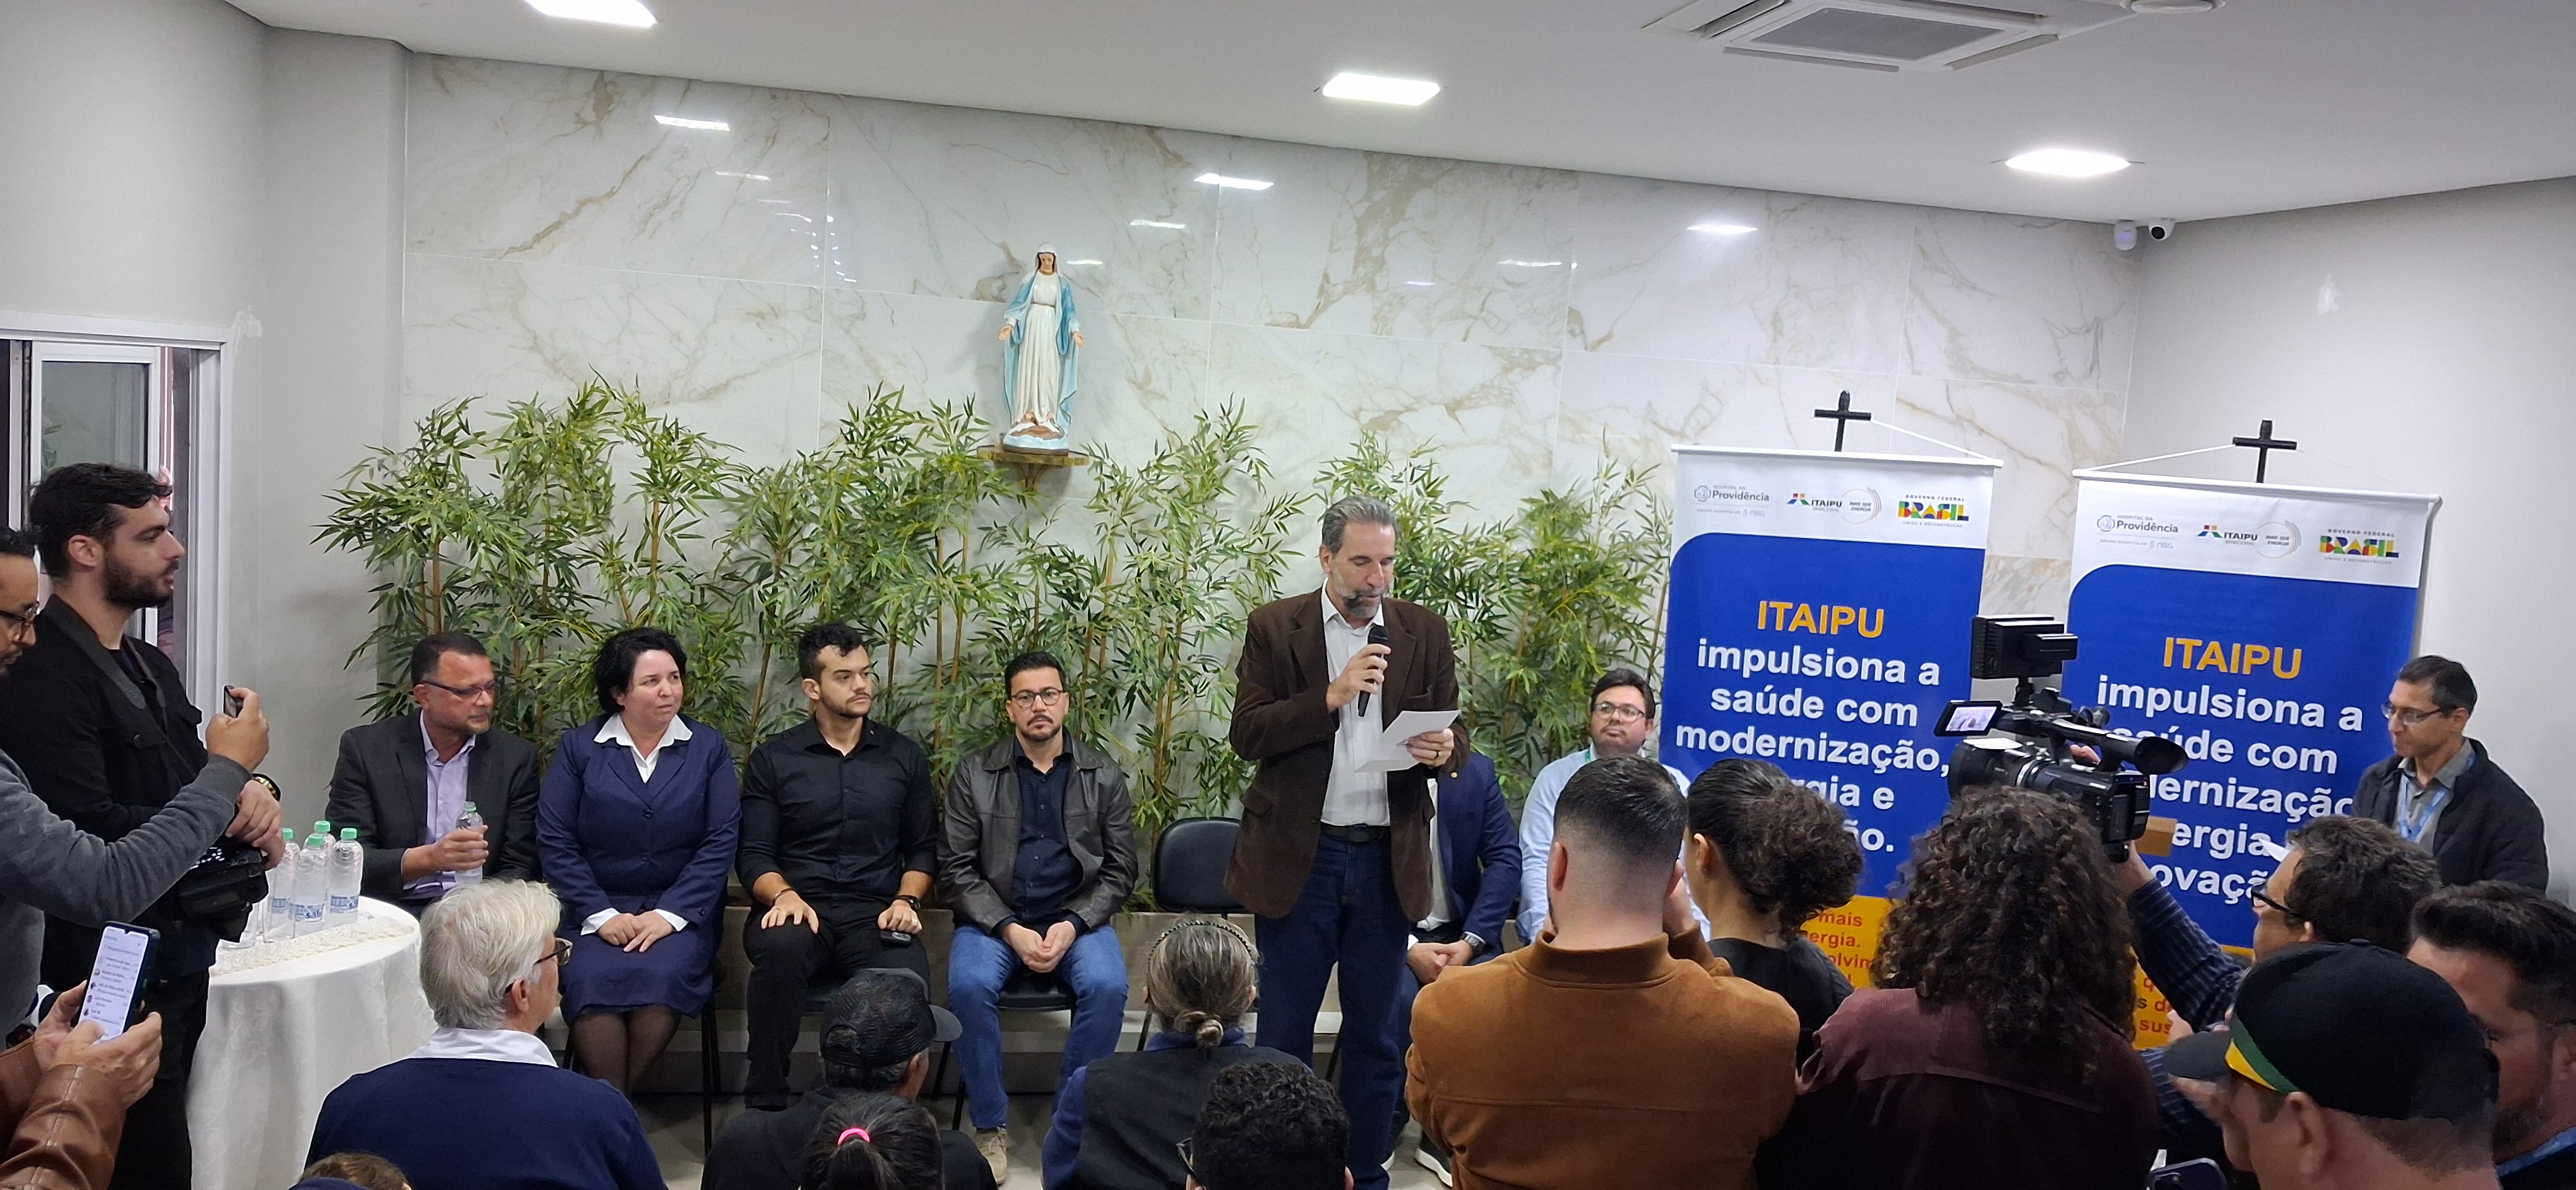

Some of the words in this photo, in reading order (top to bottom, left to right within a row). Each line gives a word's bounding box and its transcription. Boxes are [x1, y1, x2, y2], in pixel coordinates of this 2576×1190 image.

[1712, 490, 1769, 502] Providência
[1811, 499, 1842, 508] ITAIPU
[1898, 501, 1969, 521] BRASIL
[2117, 520, 2179, 532] Providência
[2224, 532, 2258, 541] ITAIPU
[2320, 536, 2399, 558] BRASIL
[1758, 600, 1885, 638] ITAIPU
[1697, 638, 1905, 683] impulsiona
[1918, 662, 1940, 685] a
[2163, 637, 2302, 680] ITAIPU
[1710, 685, 1824, 719] saúde
[1836, 699, 1918, 726] com
[2097, 675, 2325, 728] impulsiona
[2338, 705, 2363, 731] a
[1676, 724, 1950, 778] modernização,
[2247, 742, 2338, 774] com
[1873, 786, 1894, 810] e
[2171, 823, 2272, 860] ergia
[1808, 932, 1861, 949] ergia.
